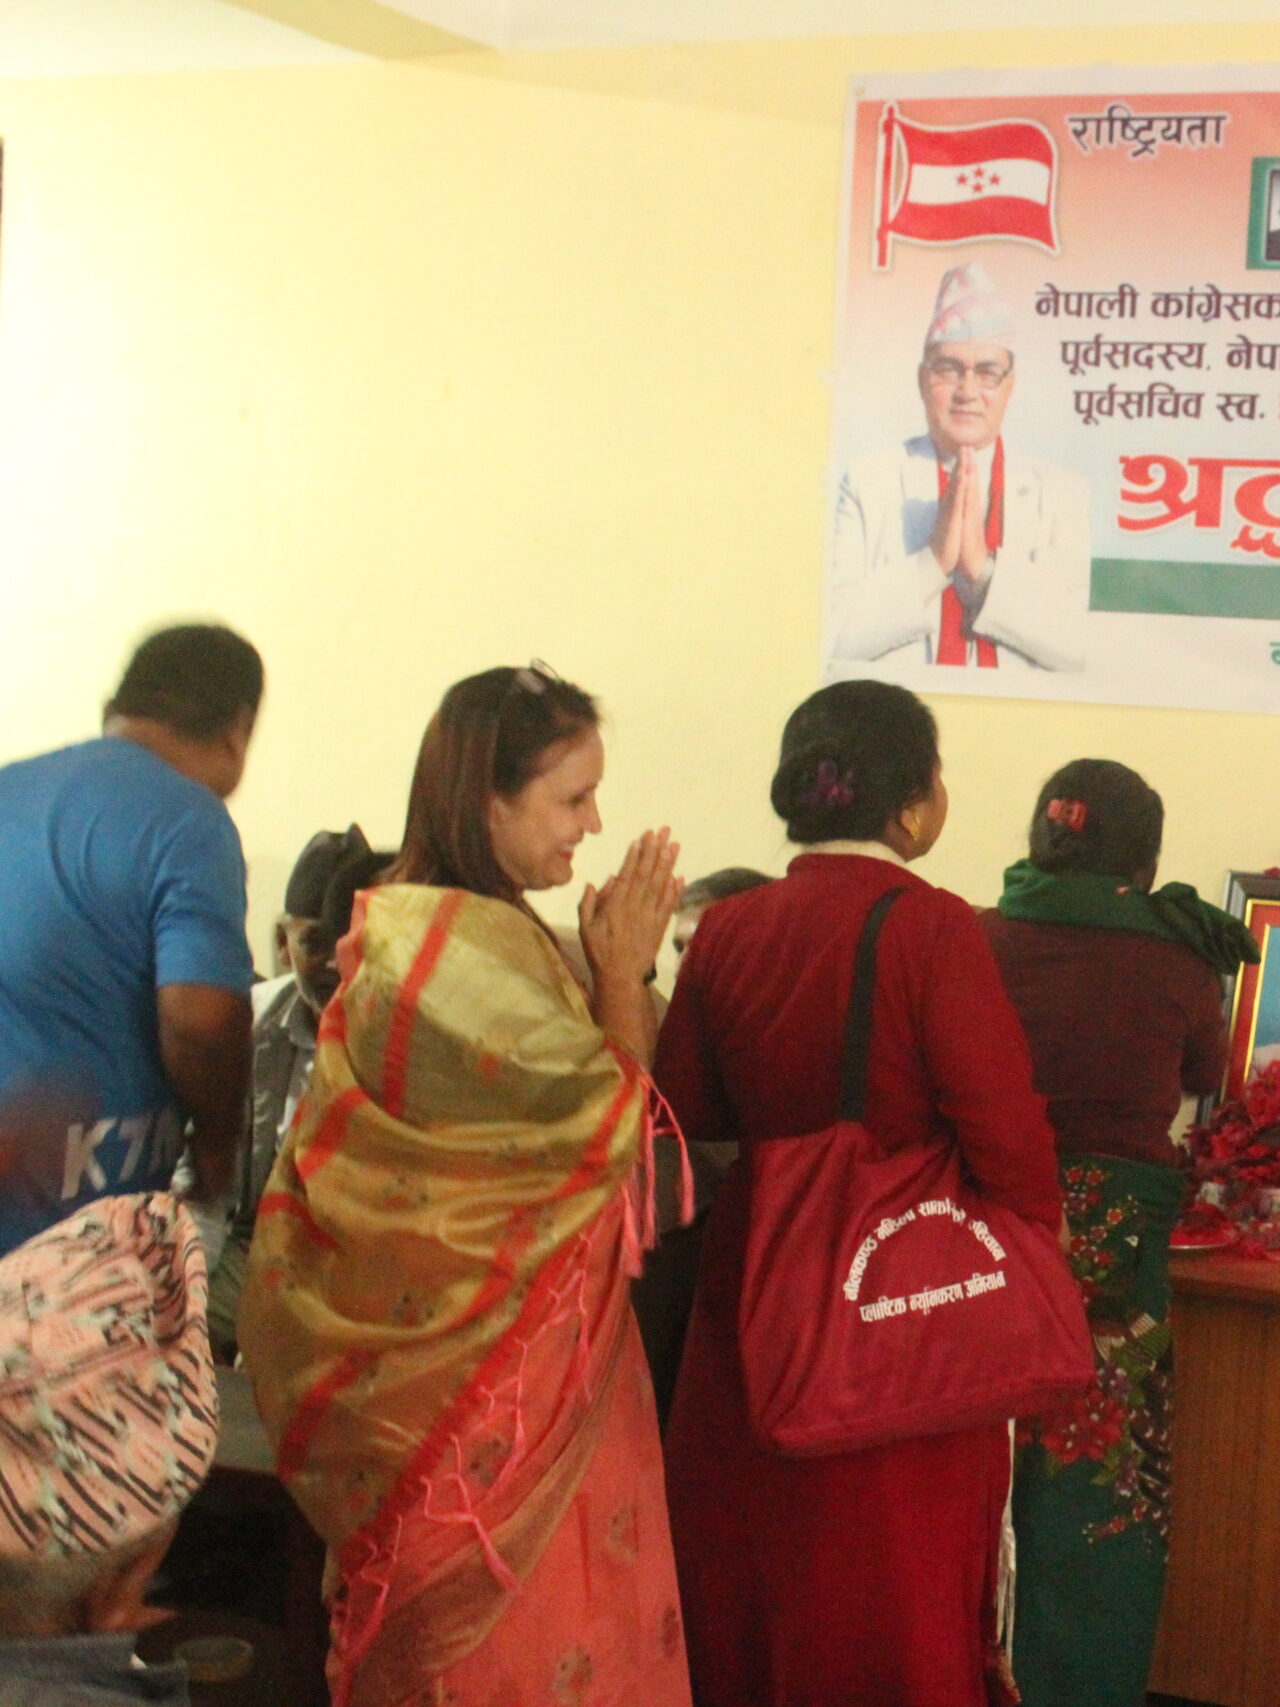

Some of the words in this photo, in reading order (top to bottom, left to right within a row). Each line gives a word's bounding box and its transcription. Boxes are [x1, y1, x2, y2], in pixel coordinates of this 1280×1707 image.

[1067, 104, 1227, 158] राष्ट्रियता
[1035, 283, 1139, 319] नेपाली
[1073, 382, 1205, 426] पूर्वसचिव
[1216, 392, 1265, 421] स्व.
[963, 1270, 1007, 1299] अभियान
